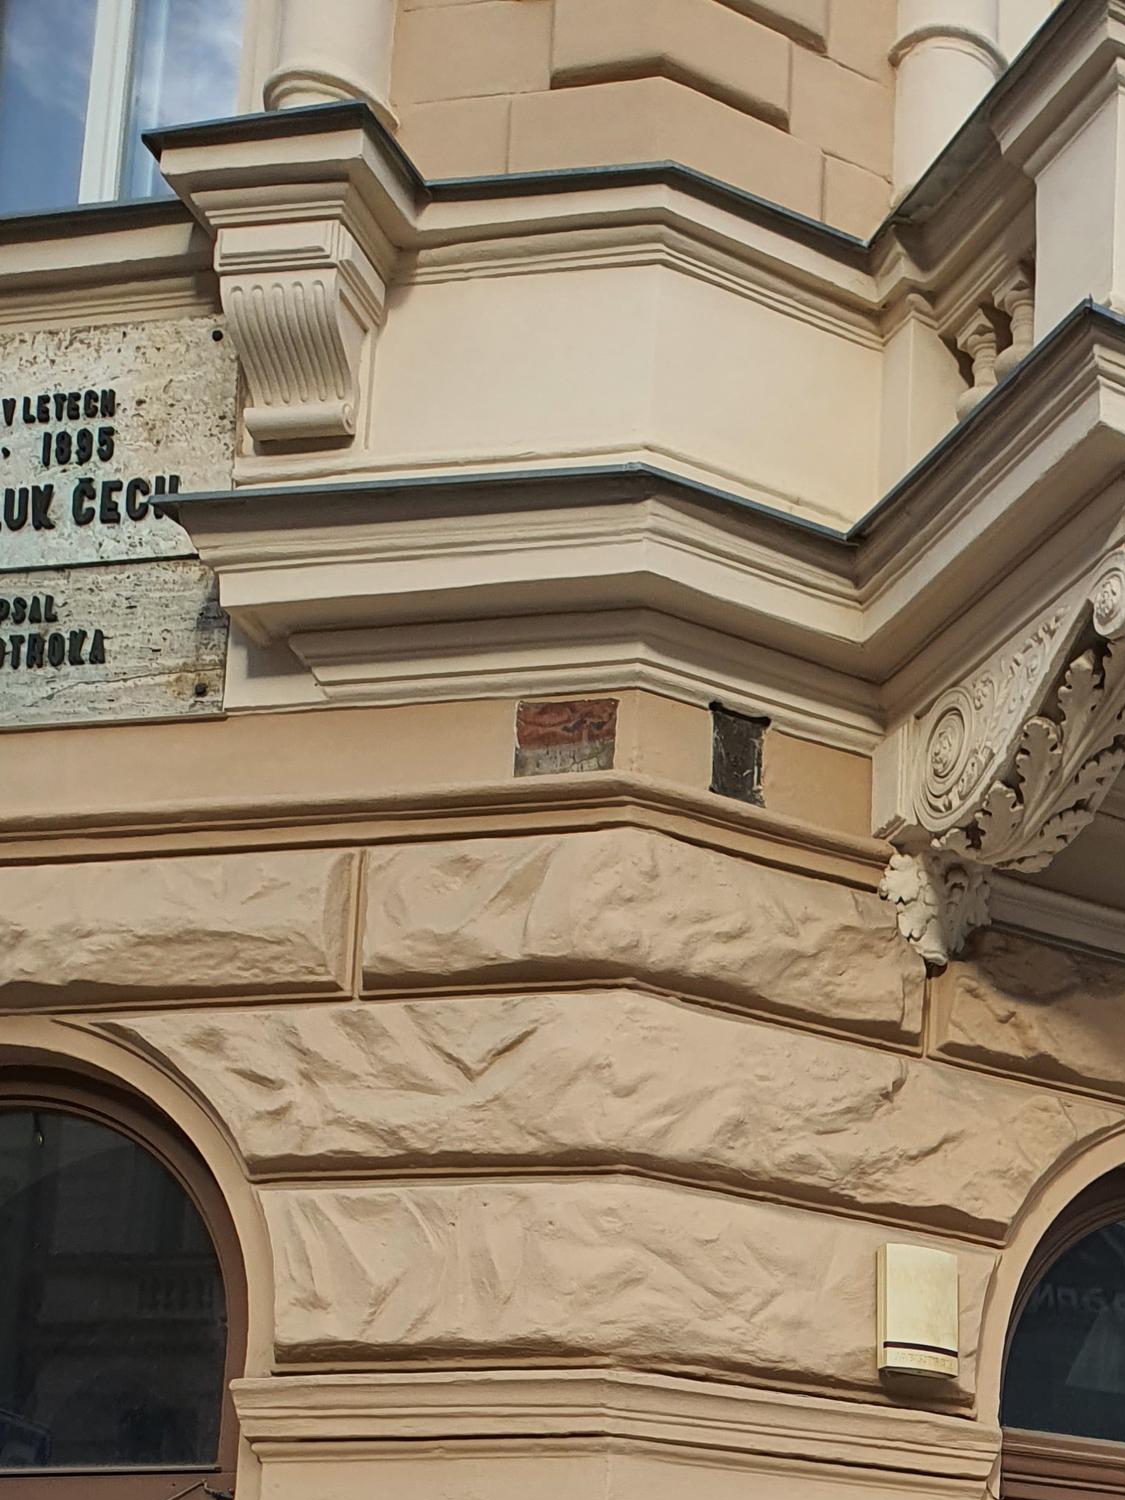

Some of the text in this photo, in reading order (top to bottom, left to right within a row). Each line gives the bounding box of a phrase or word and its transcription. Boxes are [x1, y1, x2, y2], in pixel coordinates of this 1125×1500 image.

[3, 388, 116, 426] V LETECH
[42, 427, 115, 467] 1895
[0, 475, 180, 532] UK ČECH
